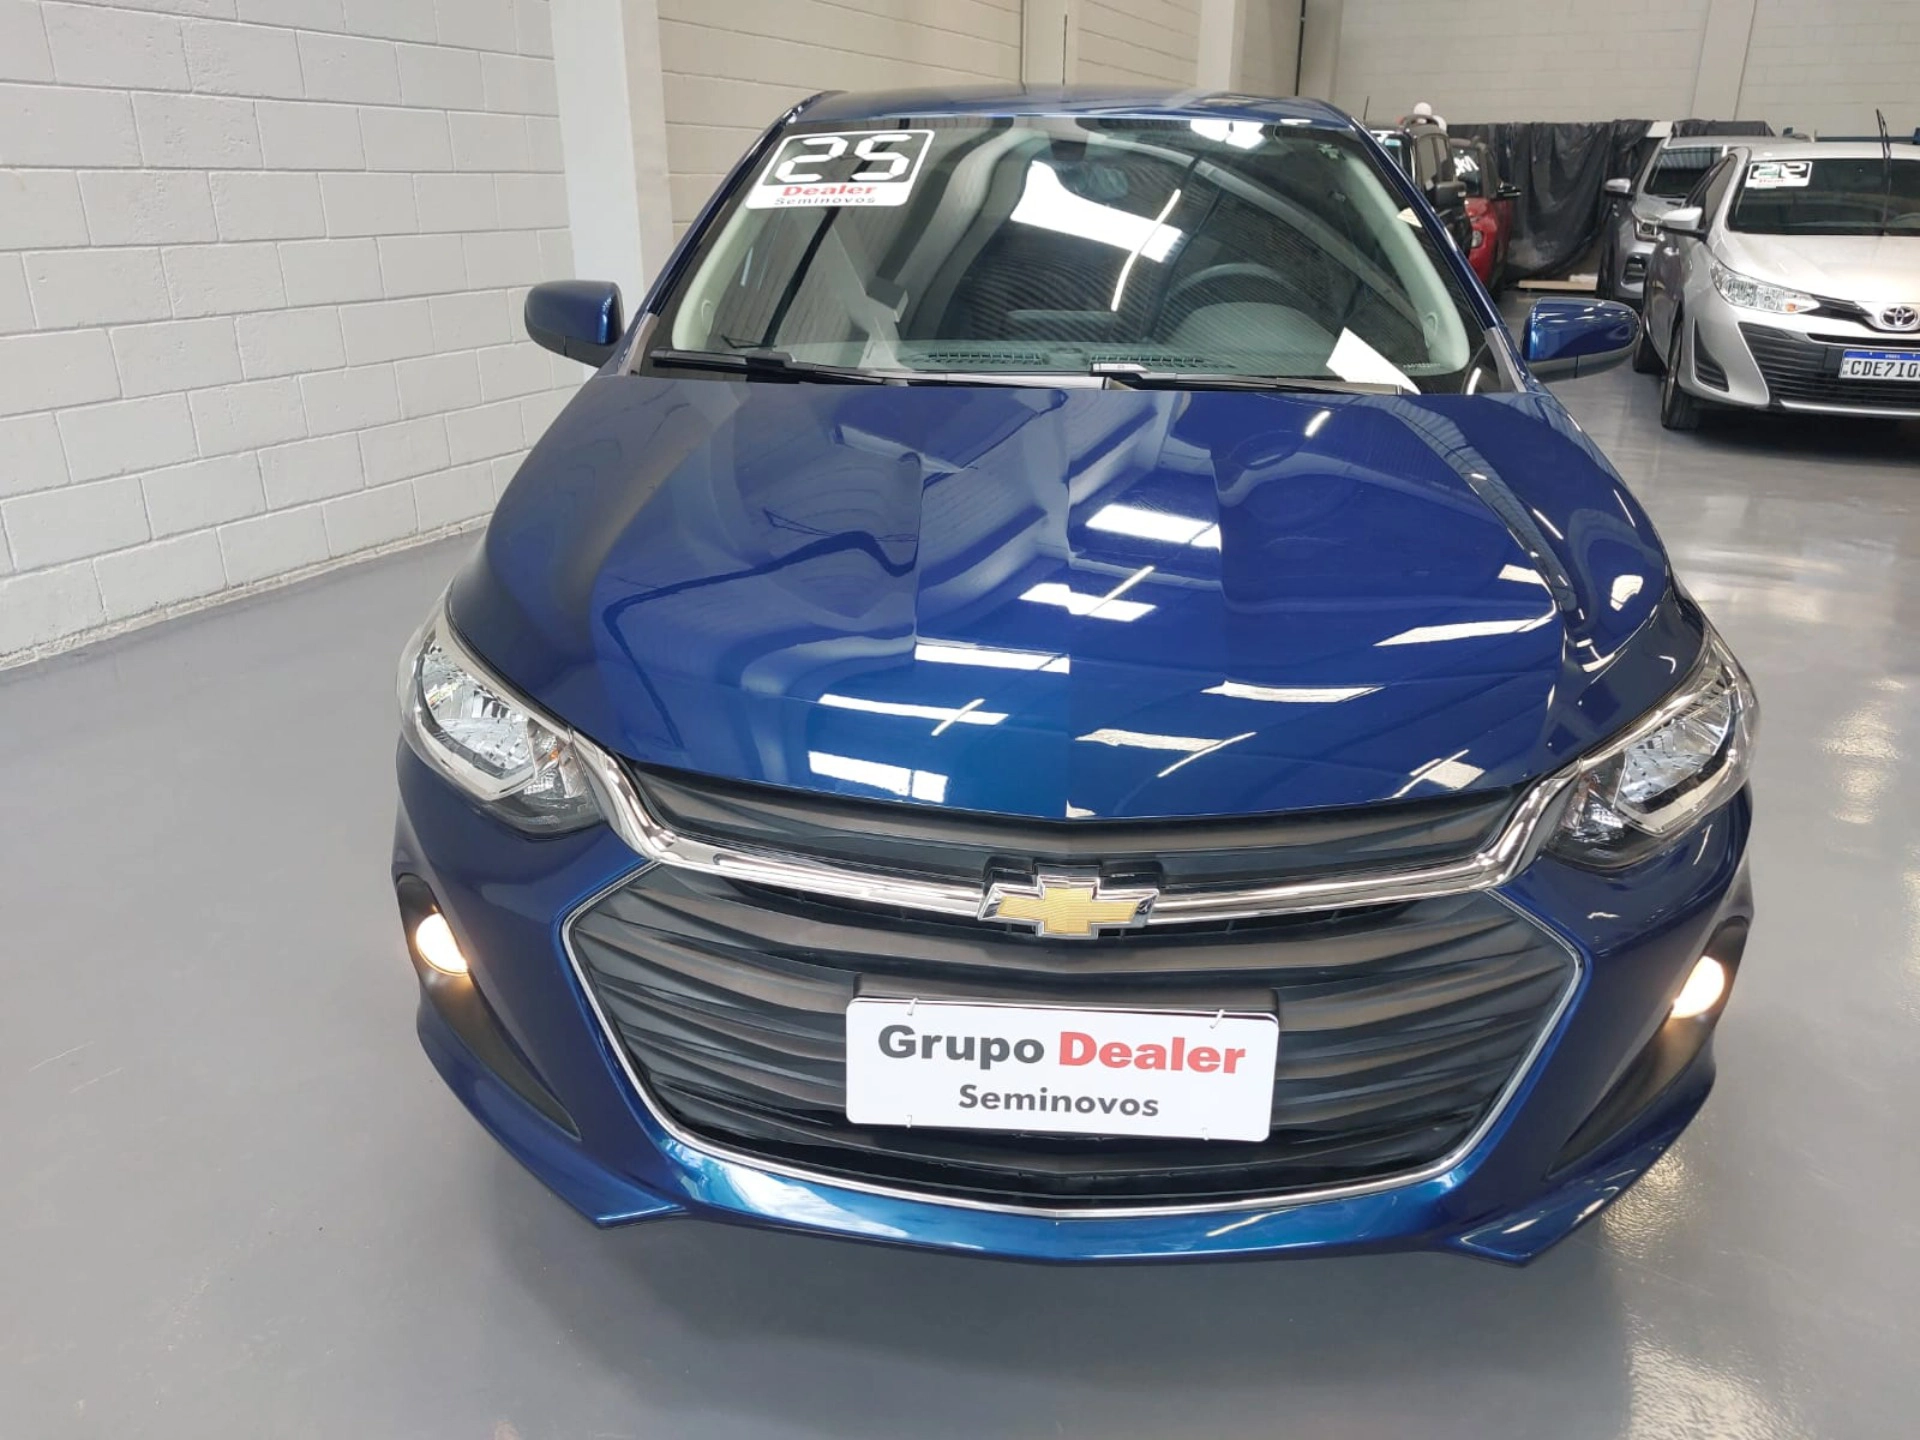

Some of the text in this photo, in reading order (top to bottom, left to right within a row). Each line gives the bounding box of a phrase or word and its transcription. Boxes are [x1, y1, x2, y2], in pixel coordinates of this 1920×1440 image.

[775, 134, 912, 183] 25
[774, 197, 876, 205] Seminovos
[782, 185, 876, 197] Dealer
[877, 1024, 1246, 1074] Grupo Dealer
[958, 1084, 1159, 1117] Seminovos
